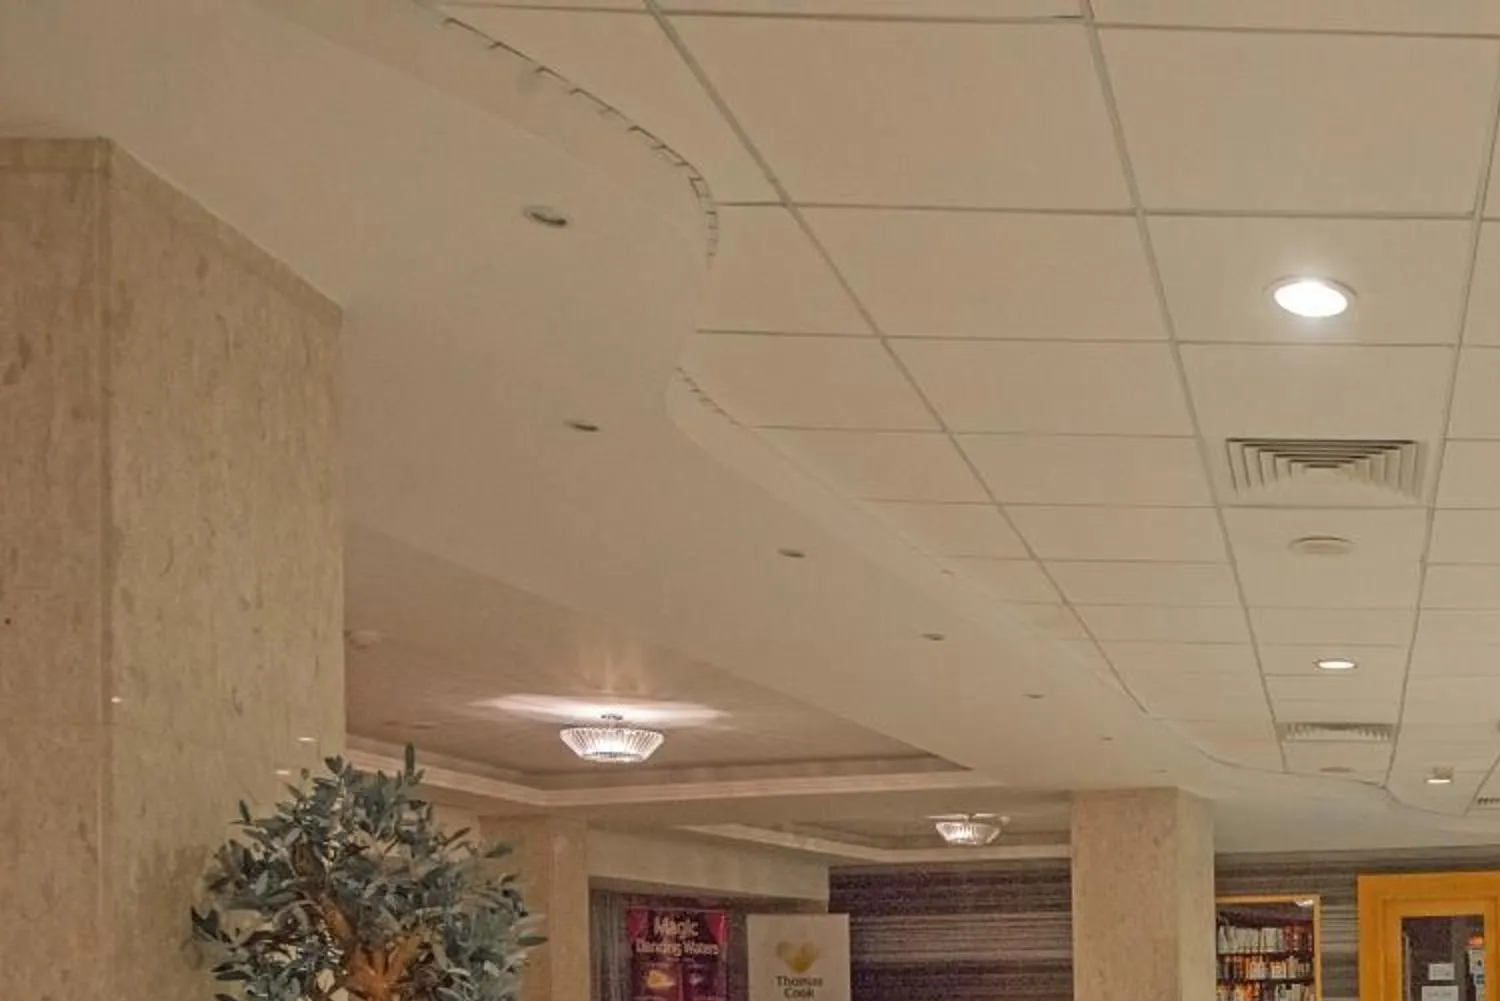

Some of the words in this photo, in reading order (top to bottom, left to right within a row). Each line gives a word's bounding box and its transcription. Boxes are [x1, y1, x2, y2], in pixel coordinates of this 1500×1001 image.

[653, 915, 699, 940] Magic
[635, 938, 682, 956] Dancing
[683, 940, 720, 955] Waters
[775, 975, 824, 987] Thomas
[784, 987, 815, 999] Cook
